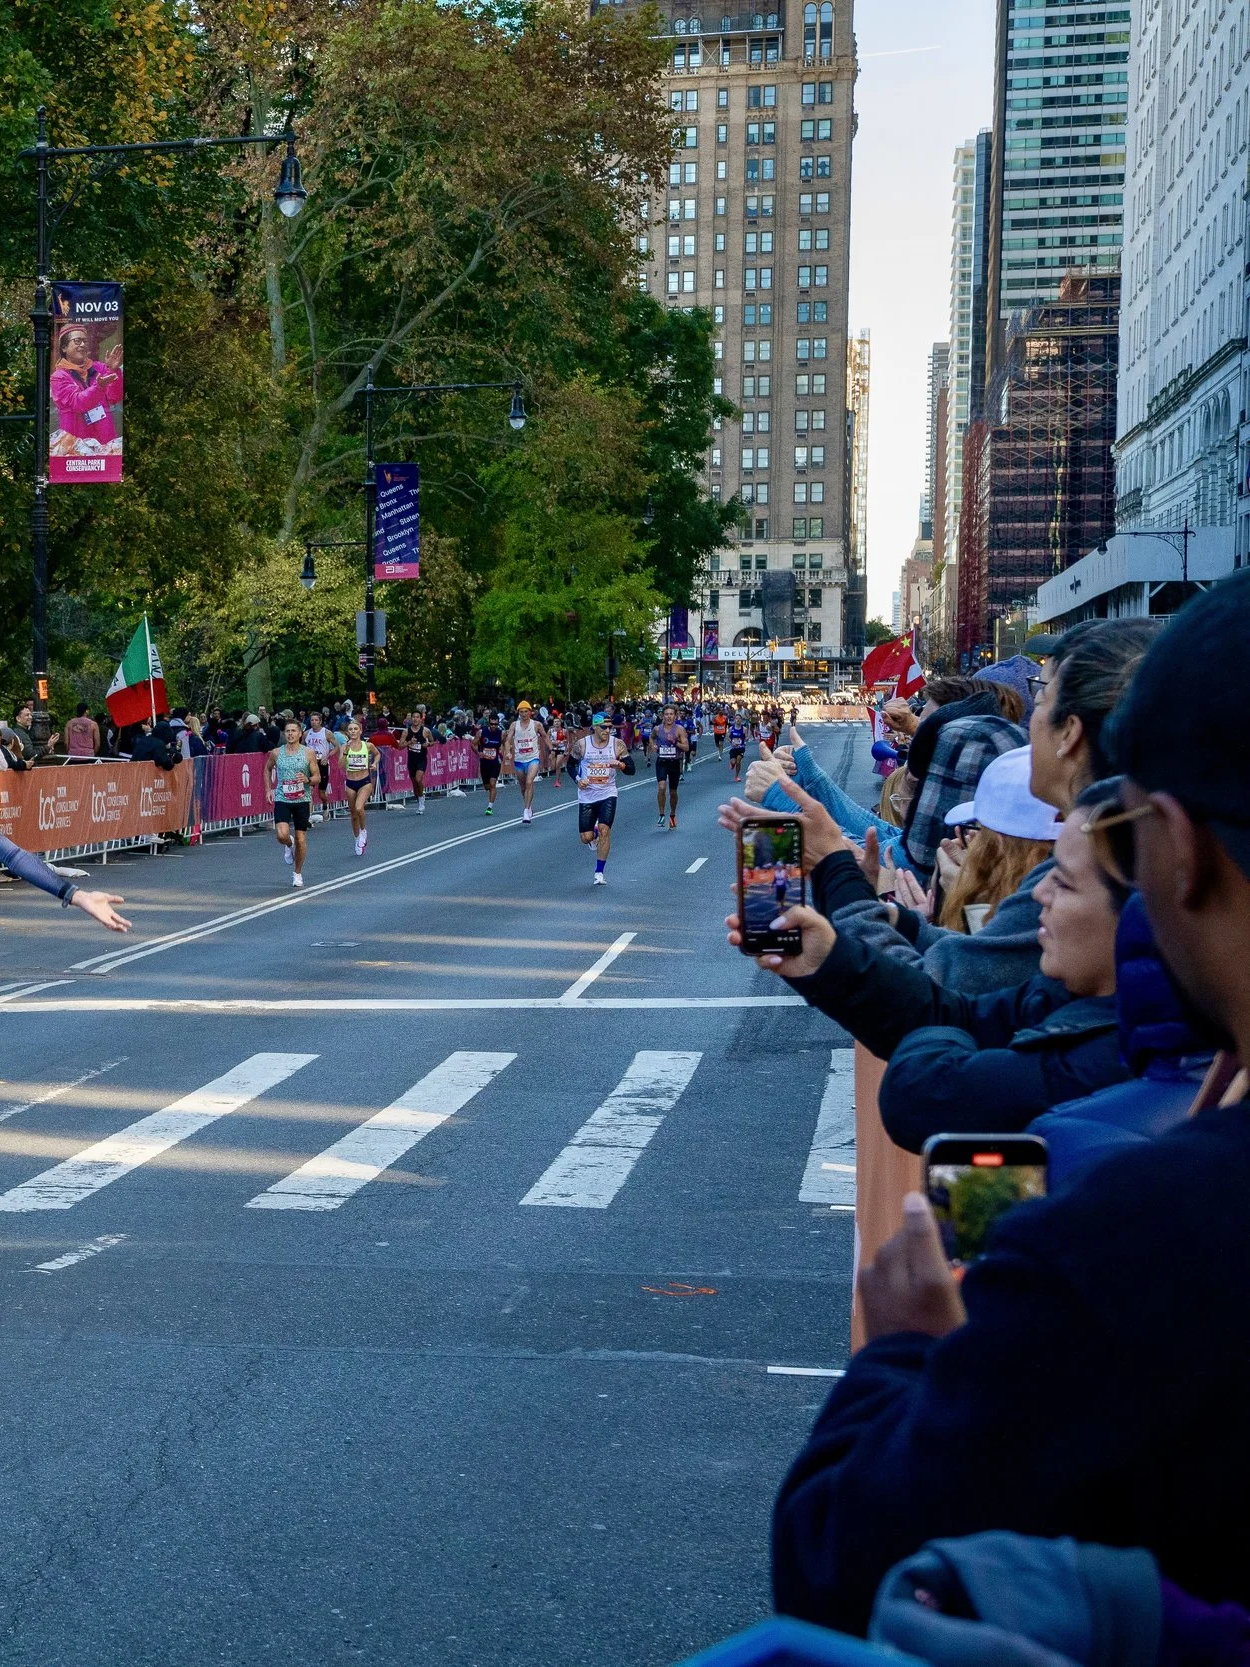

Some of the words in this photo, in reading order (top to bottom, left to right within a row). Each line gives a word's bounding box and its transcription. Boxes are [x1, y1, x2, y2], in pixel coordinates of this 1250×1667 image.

[75, 302, 102, 313] NOV
[104, 301, 119, 312] 03
[380, 483, 404, 498] Queens
[379, 498, 398, 510] Bronx
[381, 501, 415, 520] Manhattan
[399, 512, 420, 526] Staten
[386, 526, 414, 543] Brooklyn
[382, 542, 407, 557] Queens
[92, 783, 106, 823] tcs
[141, 779, 153, 817] tcs
[39, 788, 56, 831] tcs
